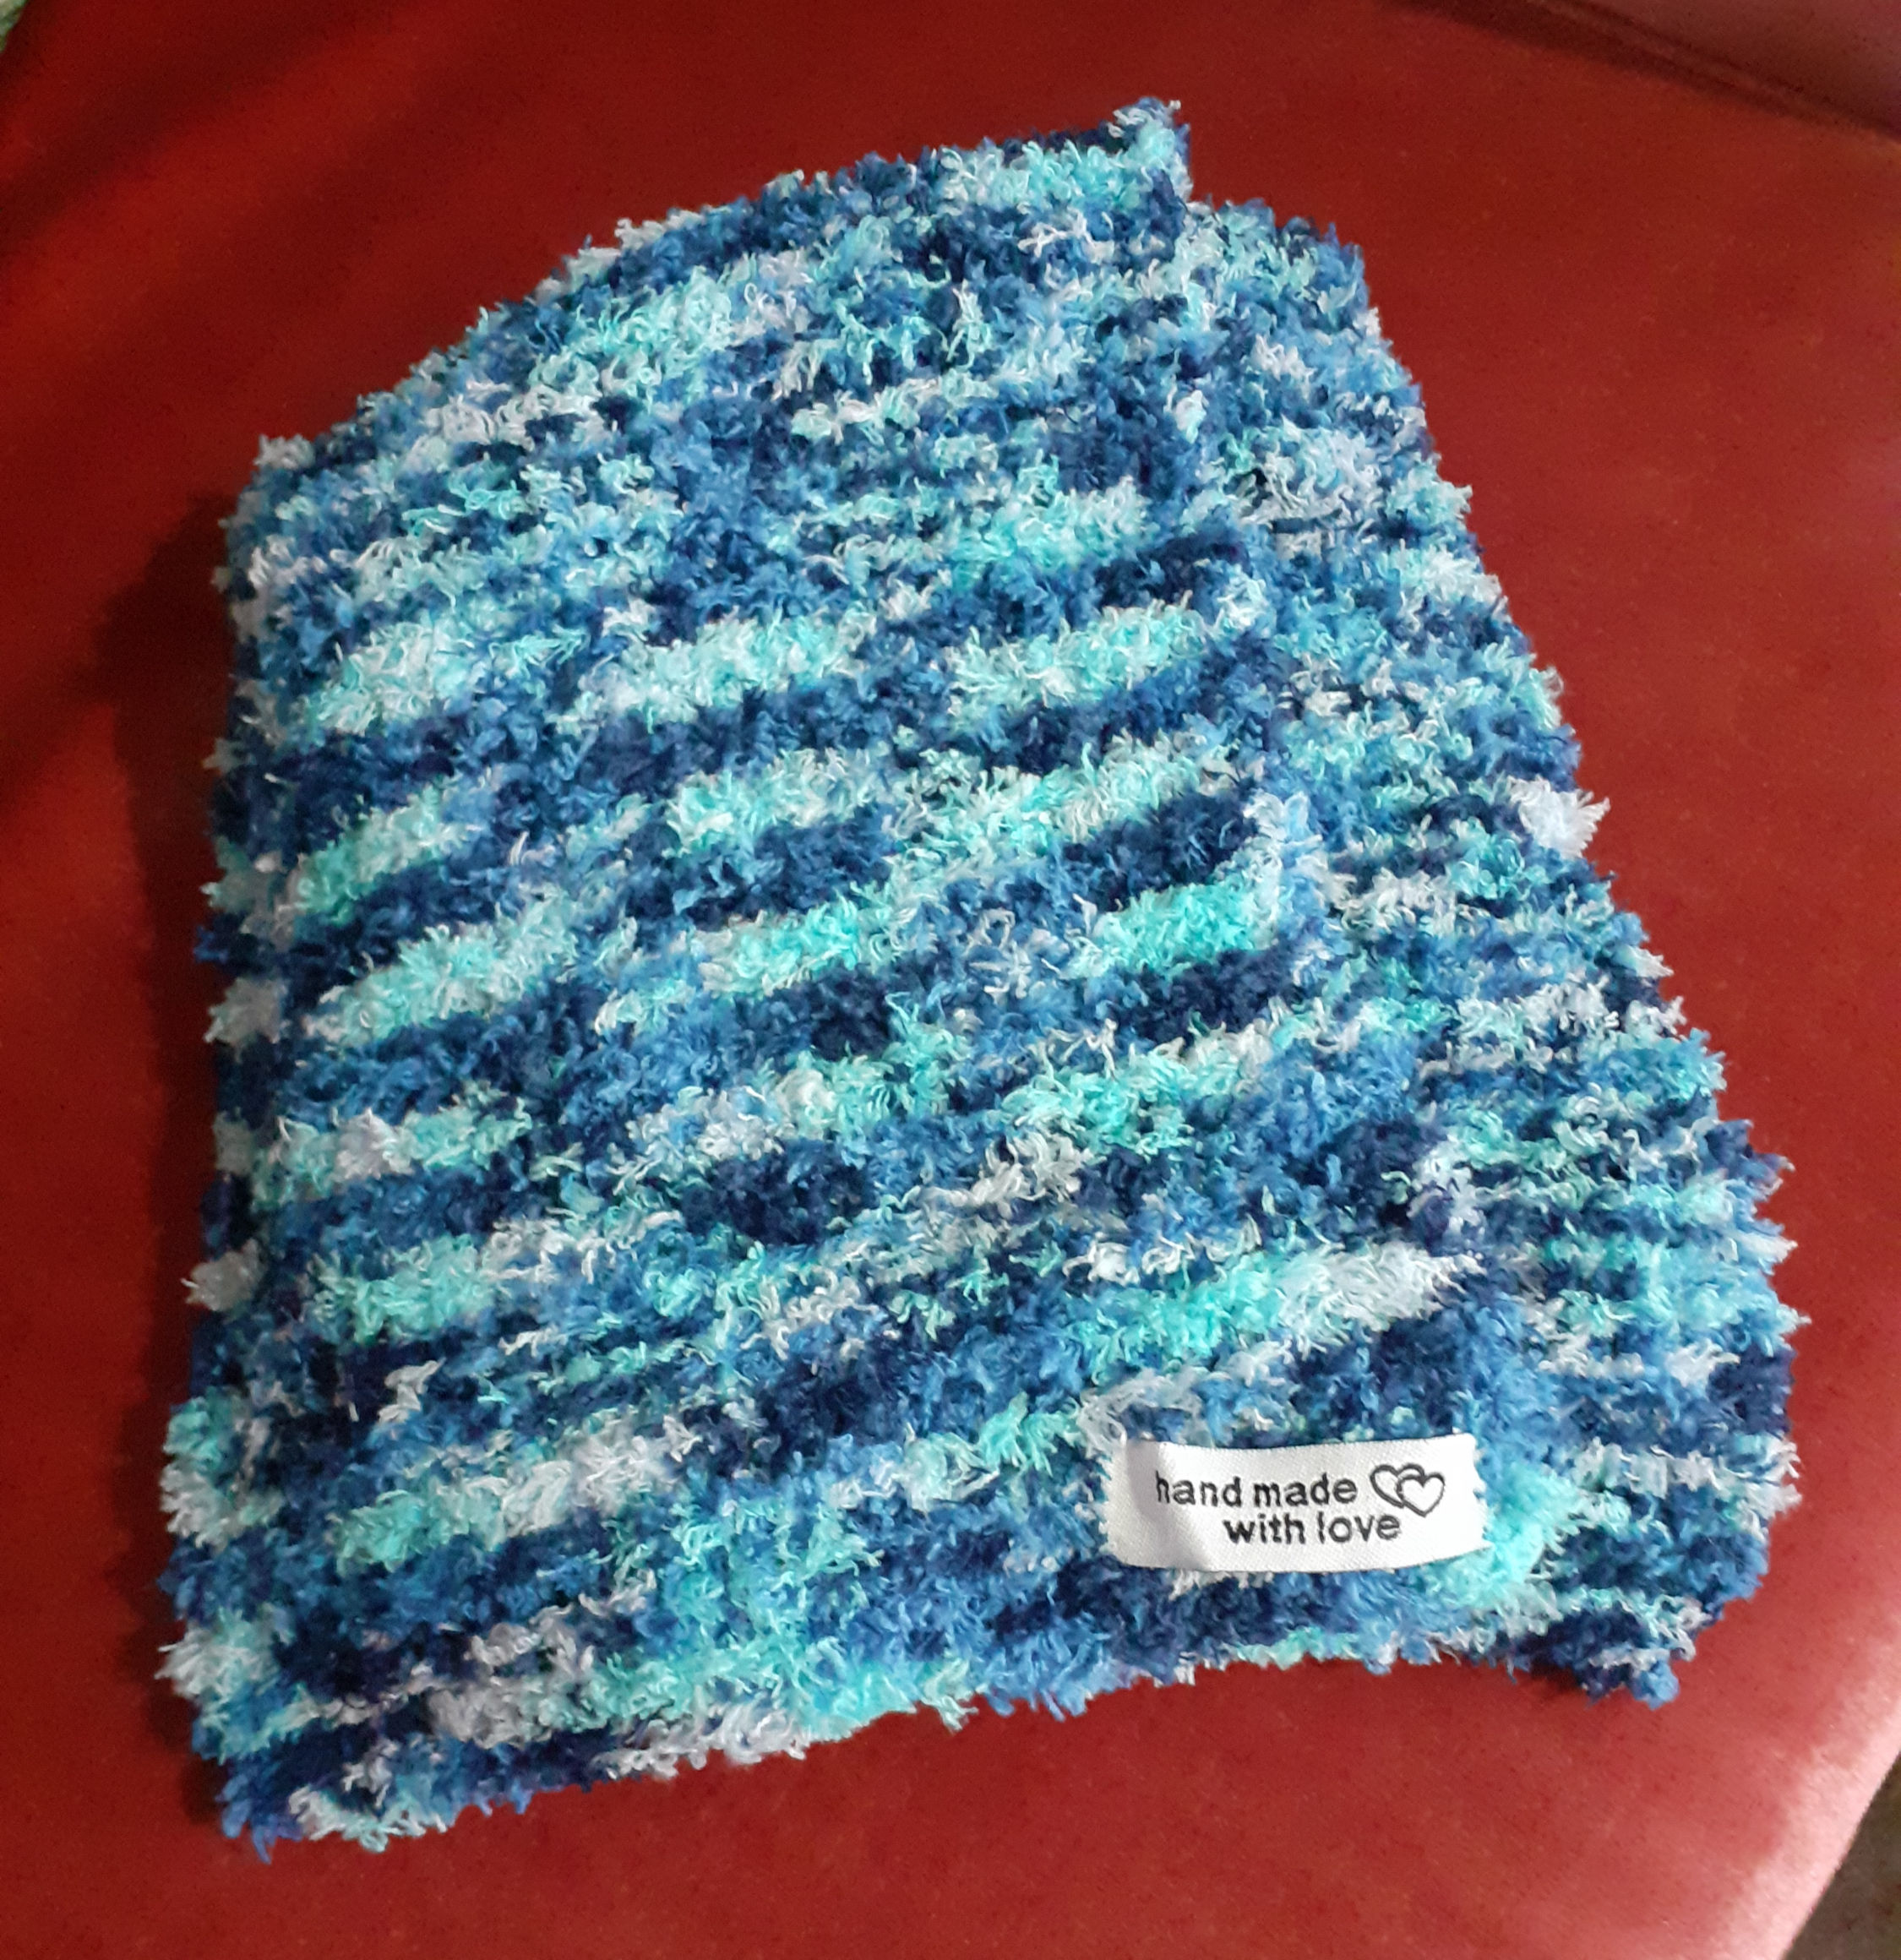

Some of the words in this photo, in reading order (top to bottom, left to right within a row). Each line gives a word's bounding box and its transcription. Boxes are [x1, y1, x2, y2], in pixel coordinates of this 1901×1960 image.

[1155, 1470, 1243, 1507] hand
[1253, 1473, 1358, 1507] made
[1223, 1513, 1306, 1544] with
[1317, 1511, 1401, 1544] love
